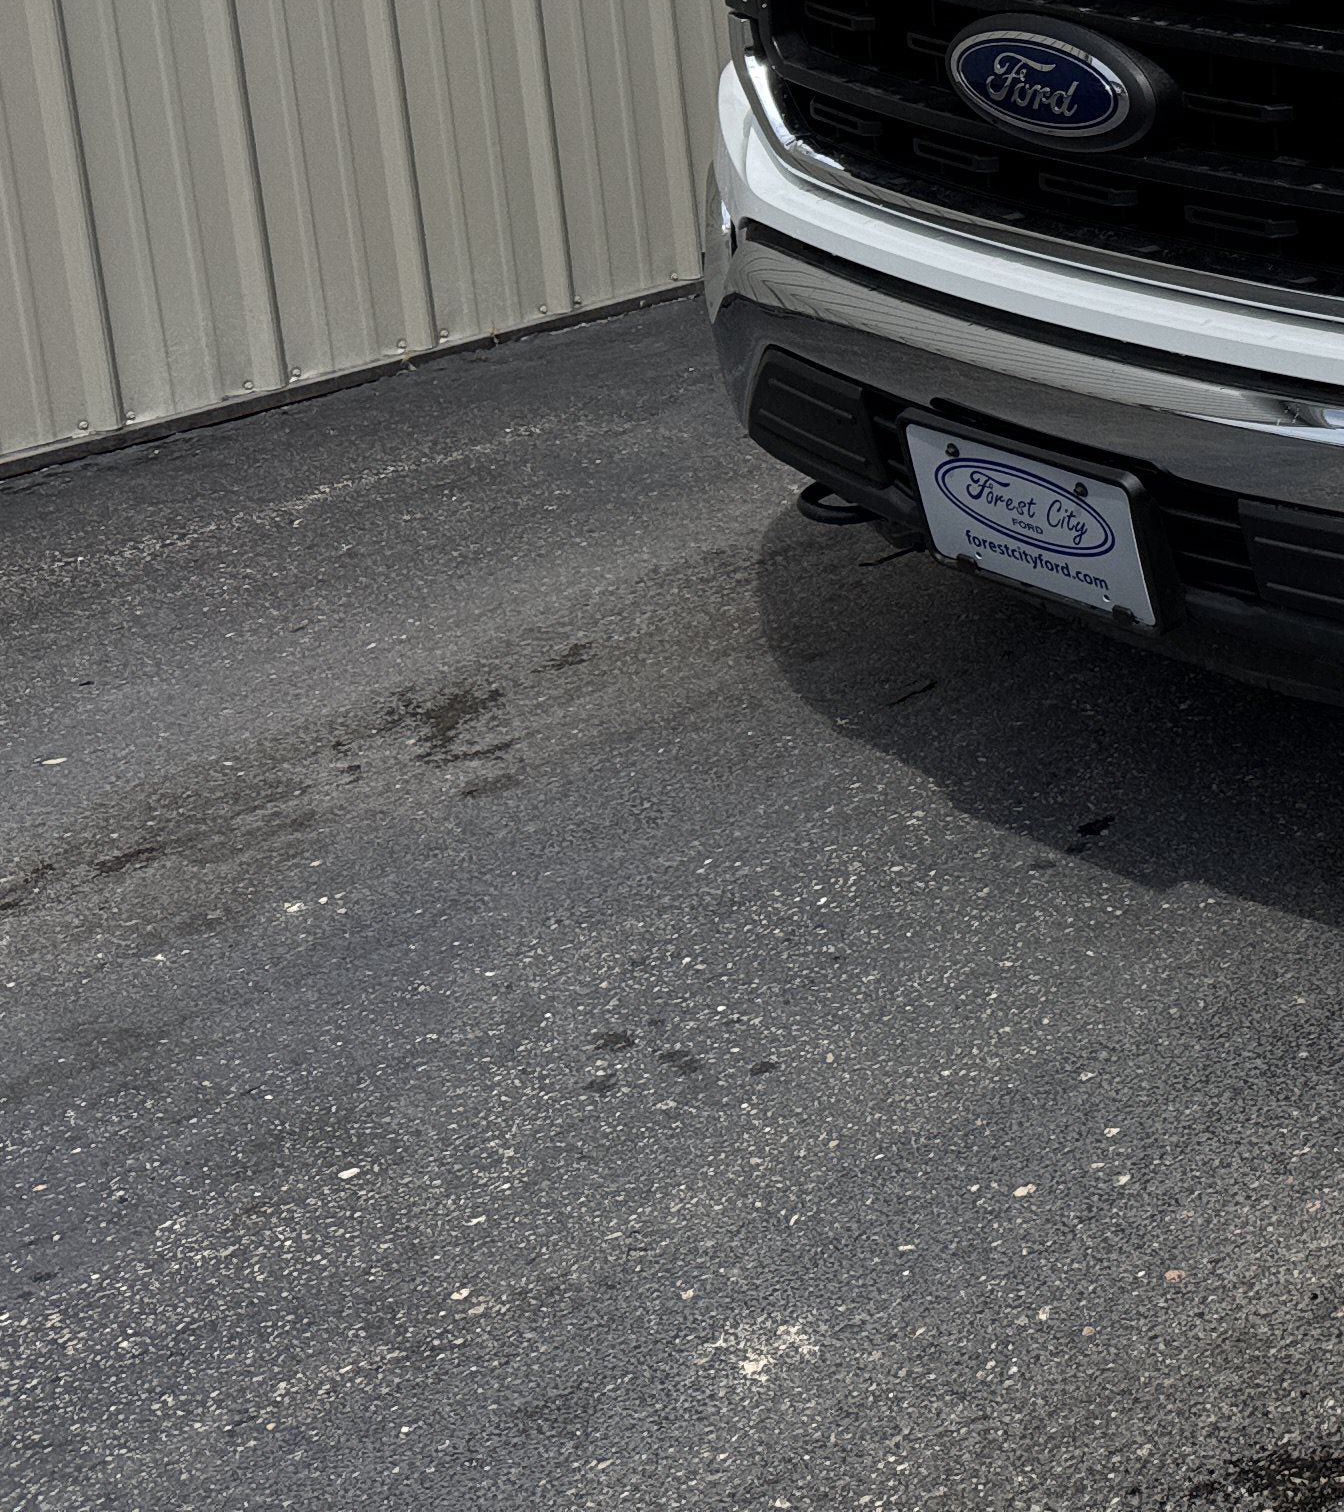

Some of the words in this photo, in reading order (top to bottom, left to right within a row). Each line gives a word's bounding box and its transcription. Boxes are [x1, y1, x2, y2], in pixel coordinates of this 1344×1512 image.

[985, 52, 1079, 117] Ford
[965, 470, 1037, 519] Forest
[1046, 499, 1089, 546] City
[1011, 517, 1044, 535] FORD
[965, 529, 1110, 591] forestcityford.com
